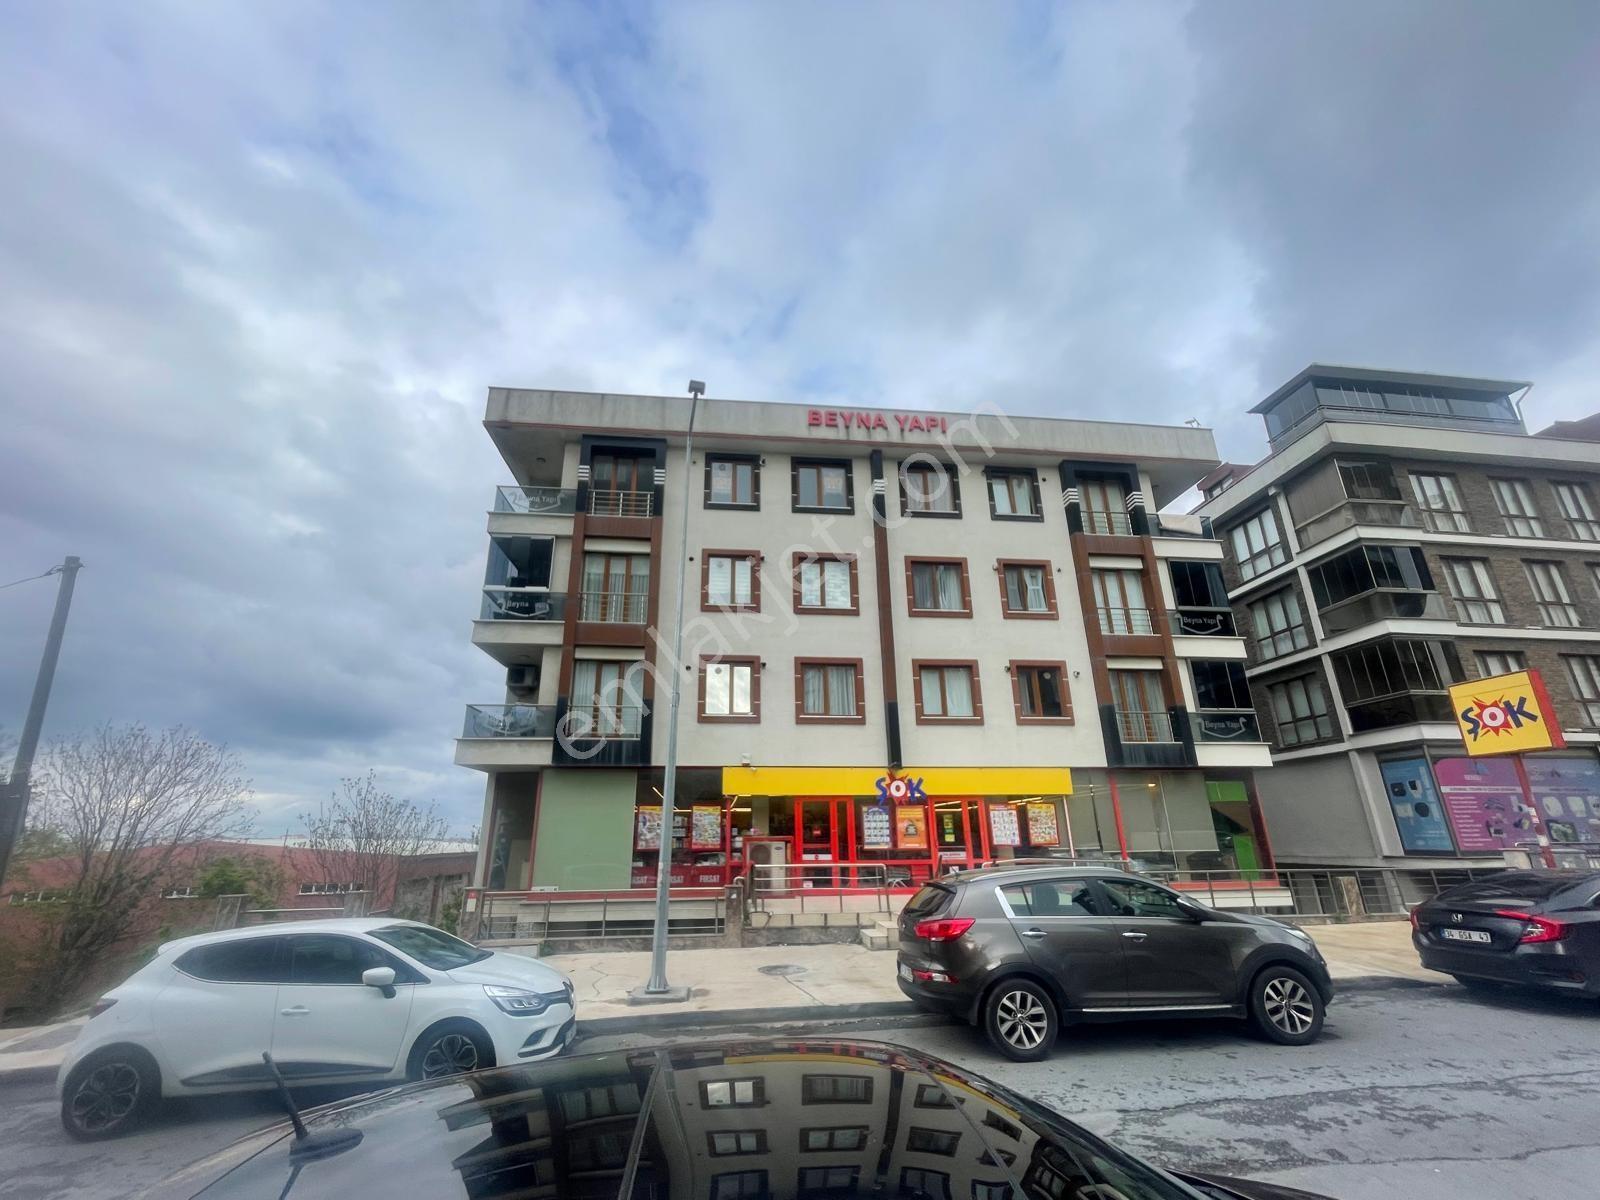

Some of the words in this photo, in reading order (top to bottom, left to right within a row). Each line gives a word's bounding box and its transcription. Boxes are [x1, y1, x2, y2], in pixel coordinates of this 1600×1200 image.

[808, 409, 888, 431] BEYNA
[894, 414, 947, 433] YAPI
[1461, 696, 1538, 742] ŞOK
